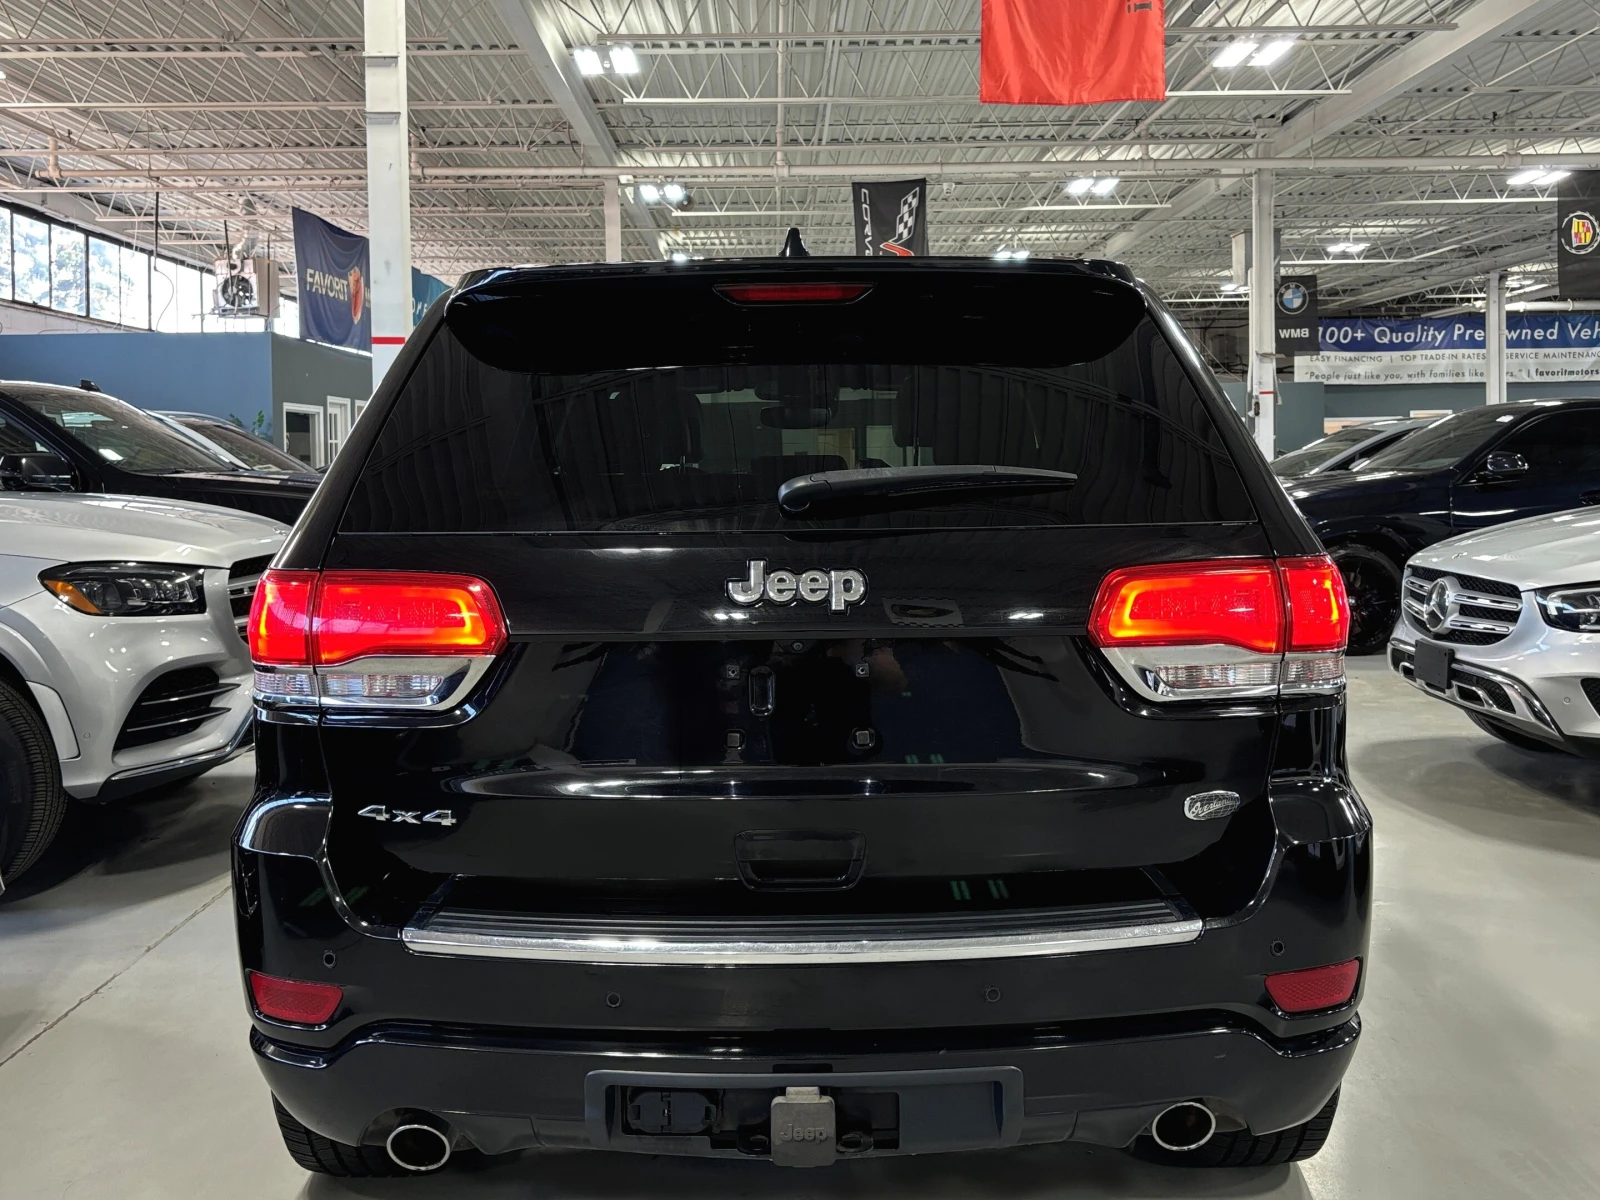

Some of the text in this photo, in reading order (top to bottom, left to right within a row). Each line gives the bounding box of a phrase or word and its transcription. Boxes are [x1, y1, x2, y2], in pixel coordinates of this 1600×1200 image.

[306, 268, 348, 302] FAVORIT
[1318, 326, 1366, 344] 100+
[1373, 324, 1446, 347] Quality
[1309, 354, 1331, 363] EASY
[1334, 355, 1383, 363] FINANCING
[1400, 354, 1417, 362] TOP
[1420, 353, 1458, 361] TRADE-IN
[1461, 352, 1486, 360] RATES
[1505, 352, 1539, 360] SERVICE
[1343, 371, 1361, 382] just
[1364, 371, 1381, 380] like
[1407, 370, 1426, 379] with
[1429, 369, 1465, 378] families
[1468, 368, 1485, 378] like
[1535, 367, 1600, 377] favoritmotors
[726, 558, 868, 614] Jeep
[780, 1123, 829, 1144] Jeep
